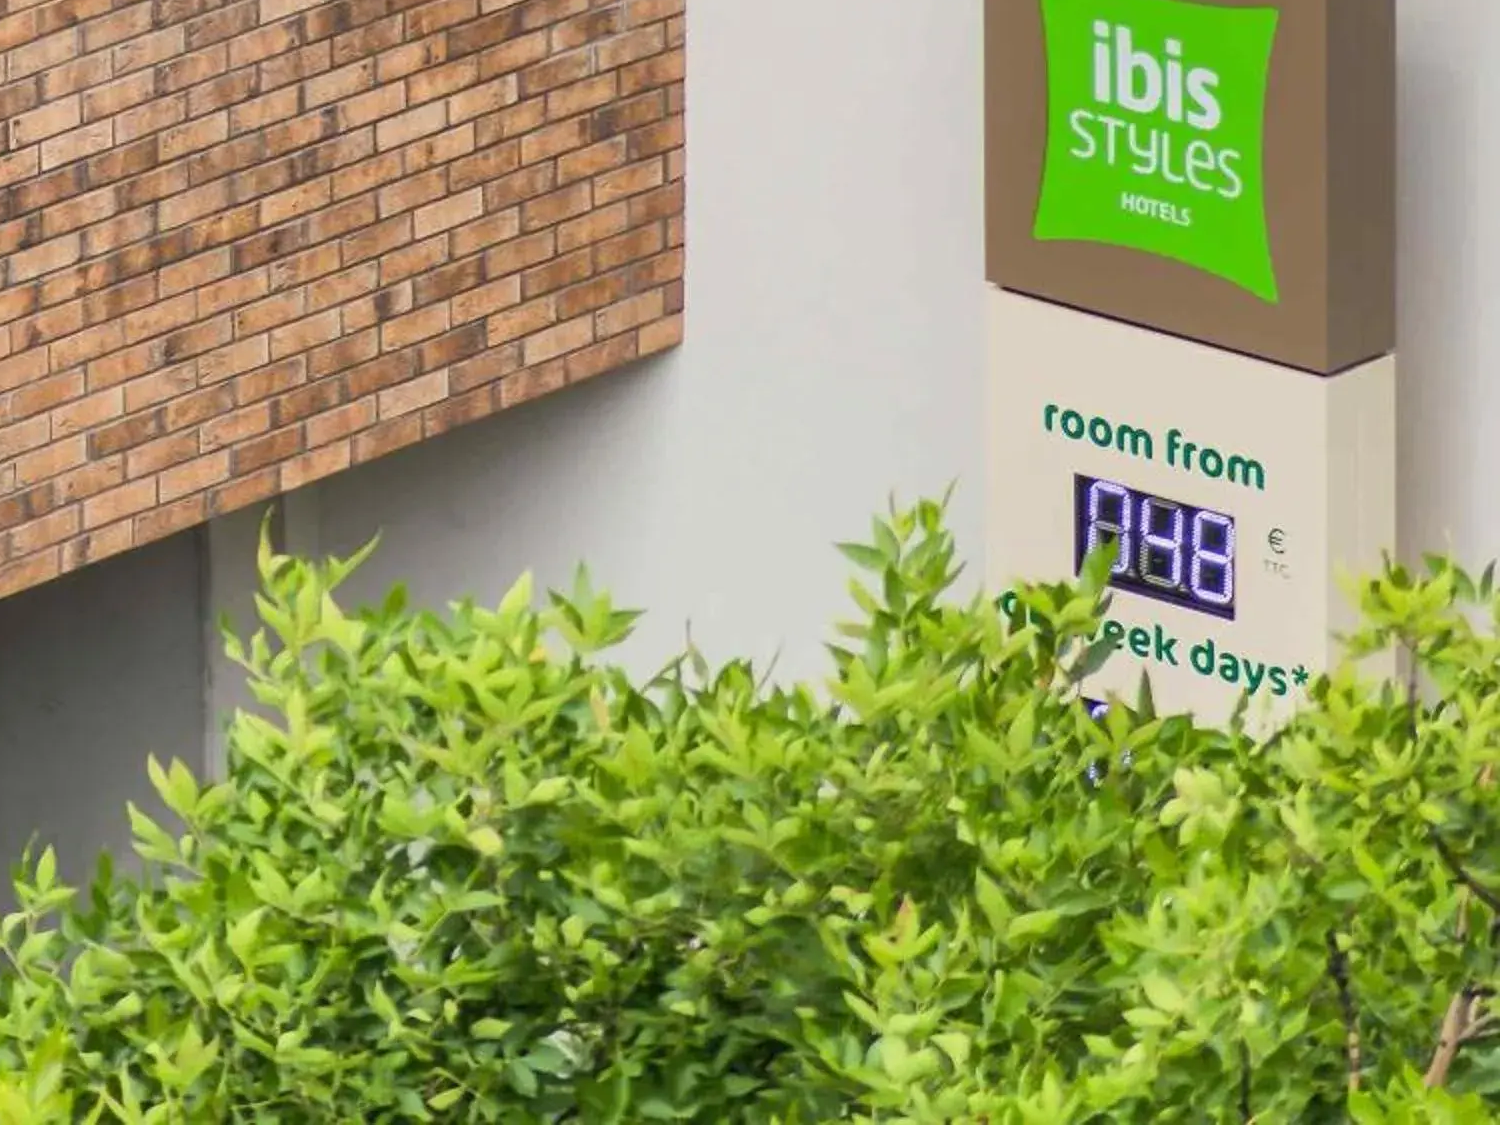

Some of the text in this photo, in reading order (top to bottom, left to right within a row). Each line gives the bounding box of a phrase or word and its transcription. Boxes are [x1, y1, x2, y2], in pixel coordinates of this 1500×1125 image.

[1092, 19, 1222, 131] ibis
[1121, 192, 1193, 227] HOTELS
[1043, 403, 1266, 490] room from
[1267, 527, 1286, 555] €
[1083, 620, 1179, 667] eek
